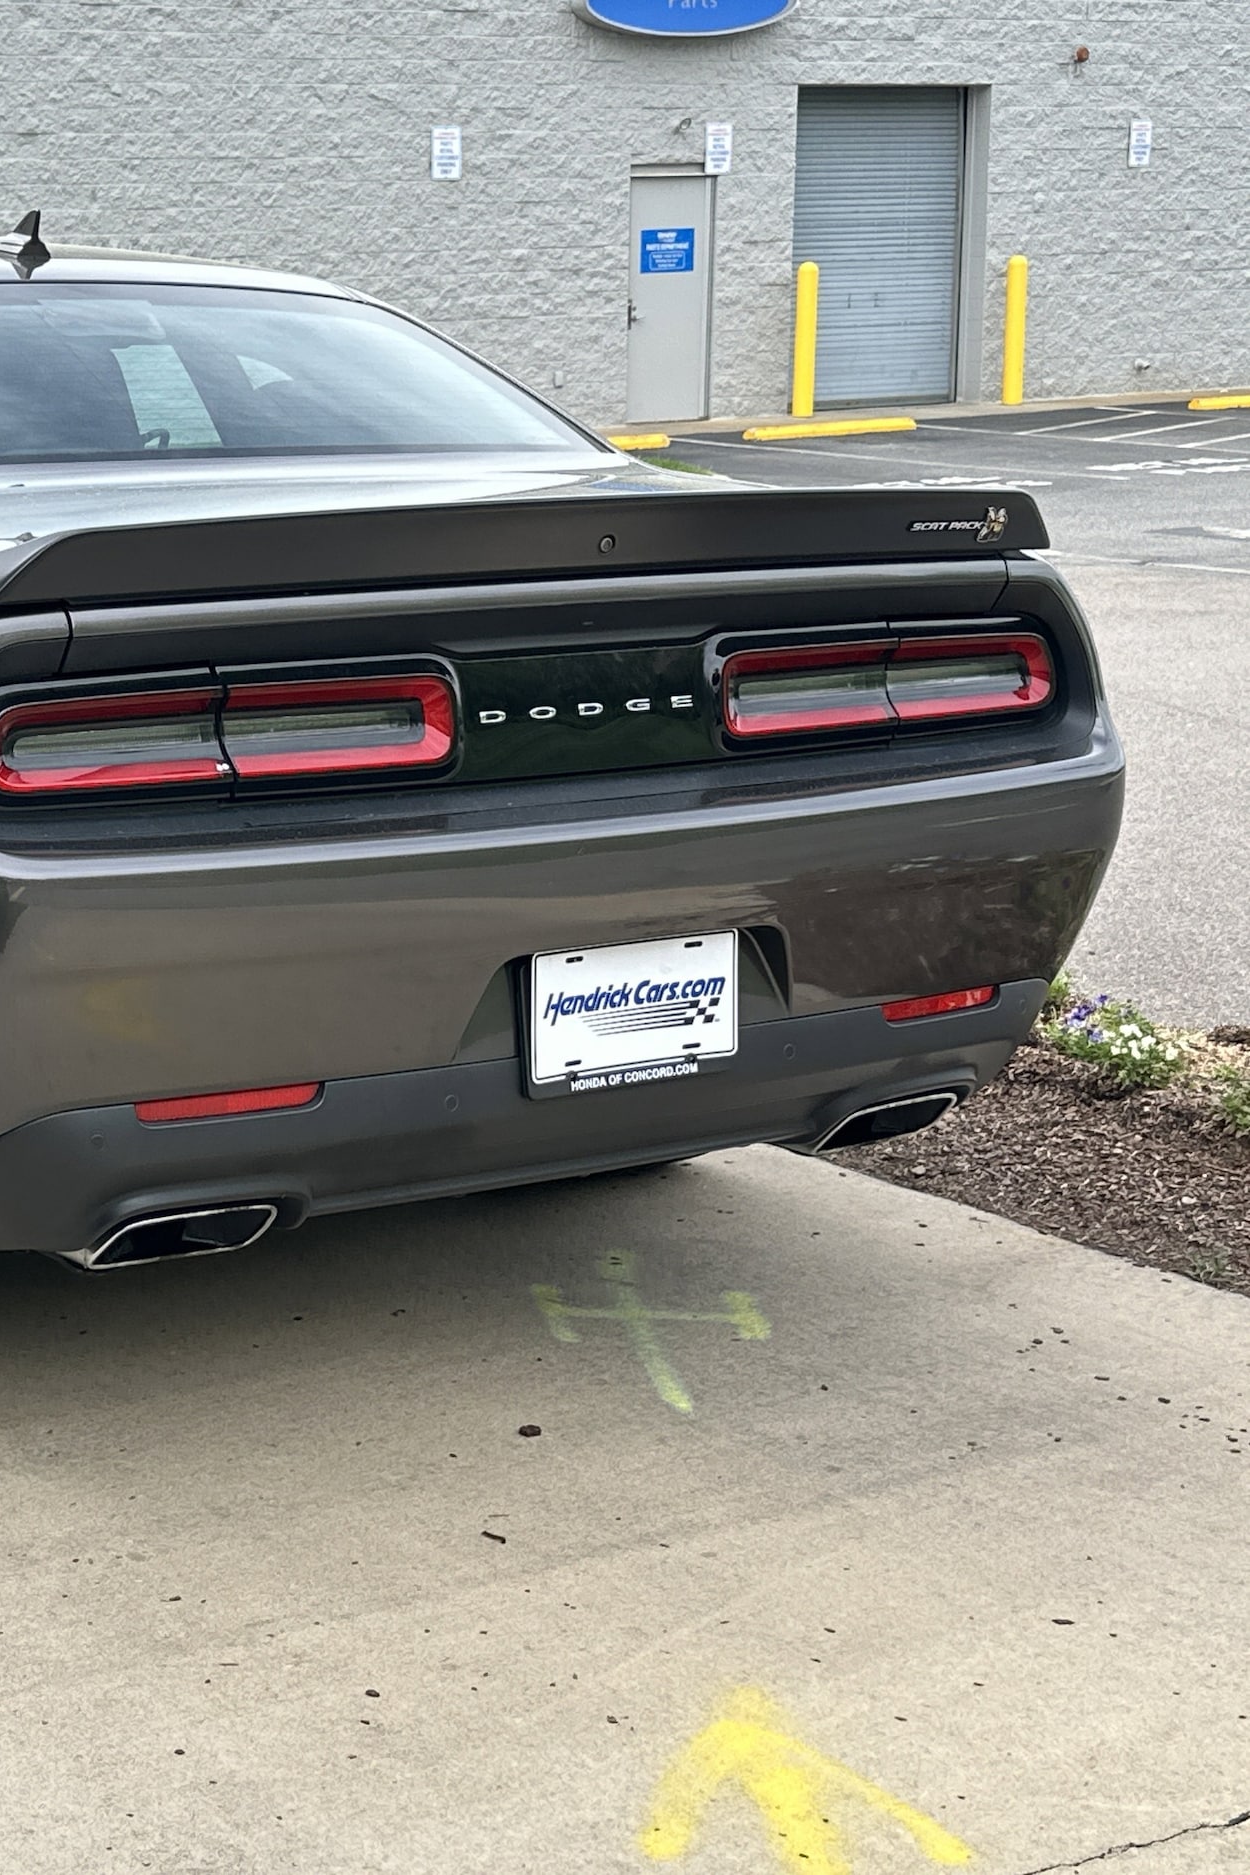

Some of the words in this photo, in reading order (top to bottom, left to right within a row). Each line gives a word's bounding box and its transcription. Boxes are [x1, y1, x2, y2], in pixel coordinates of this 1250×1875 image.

[910, 522, 949, 532] SCAT
[948, 521, 984, 531] PACK
[479, 695, 693, 724] DODGE
[570, 1076, 607, 1092] HONDA
[608, 1074, 623, 1086] OF
[625, 1062, 698, 1083] CONCORD.COM
